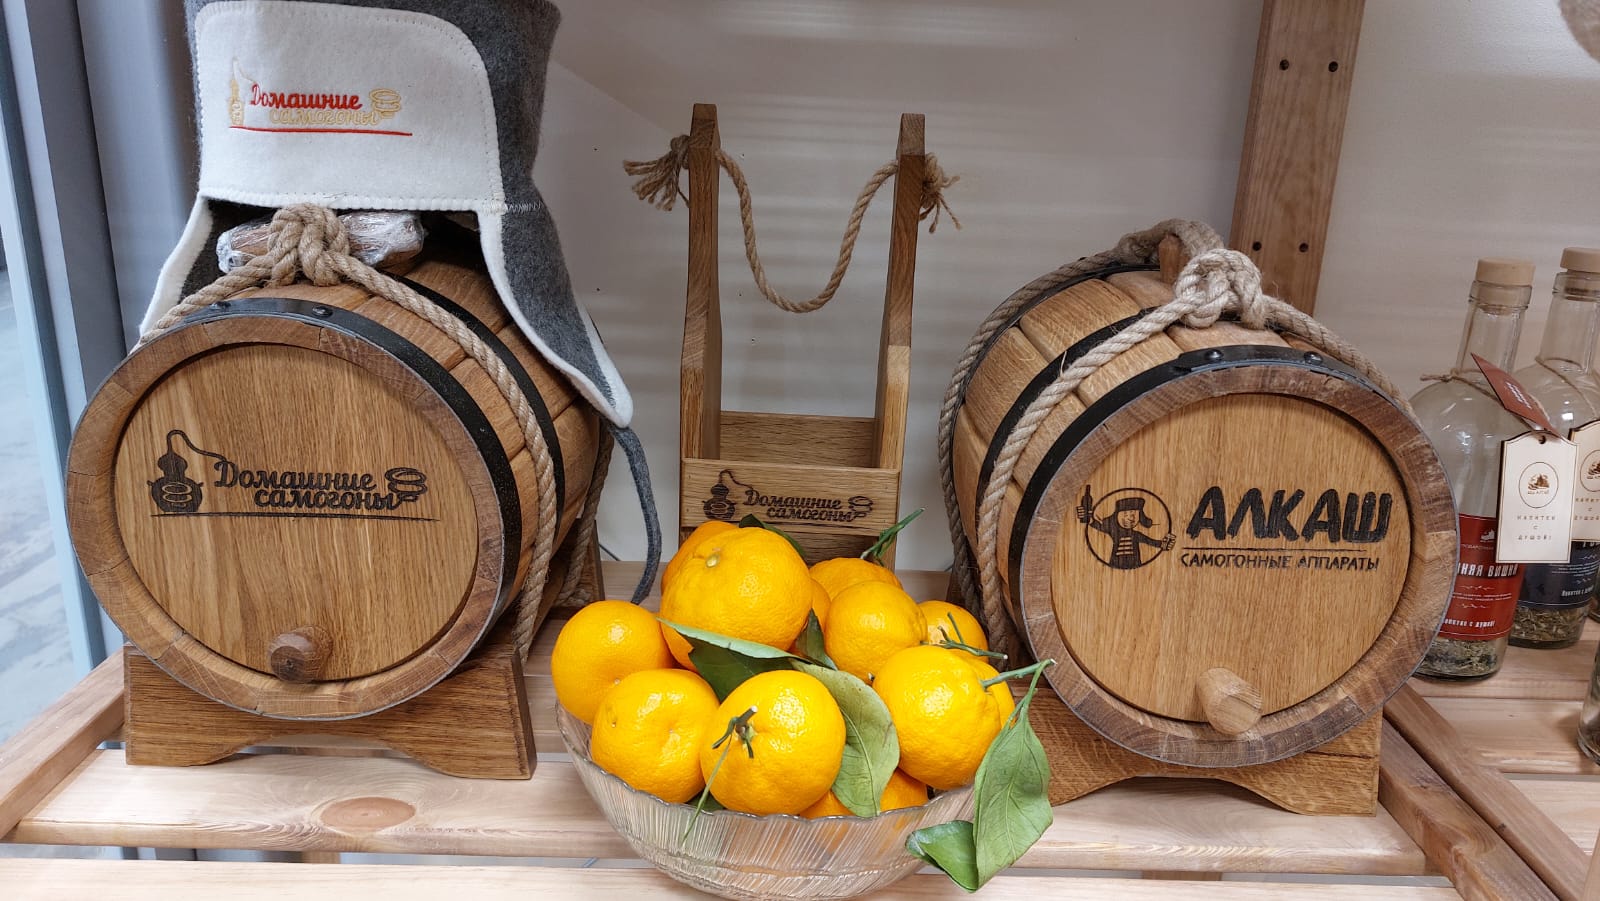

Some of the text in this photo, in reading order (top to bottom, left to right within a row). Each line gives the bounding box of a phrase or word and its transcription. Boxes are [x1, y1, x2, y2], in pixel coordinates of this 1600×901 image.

[251, 83, 363, 110] Домашние
[269, 109, 382, 126] самогоны
[213, 460, 377, 490] Домашние
[254, 489, 402, 511] самогоны
[742, 489, 843, 509] Домашние
[766, 506, 856, 523] самогоны
[1185, 485, 1393, 544] АЛКАШ
[1180, 553, 1380, 572] САМОГОННЫЕ АППАРАТЫ
